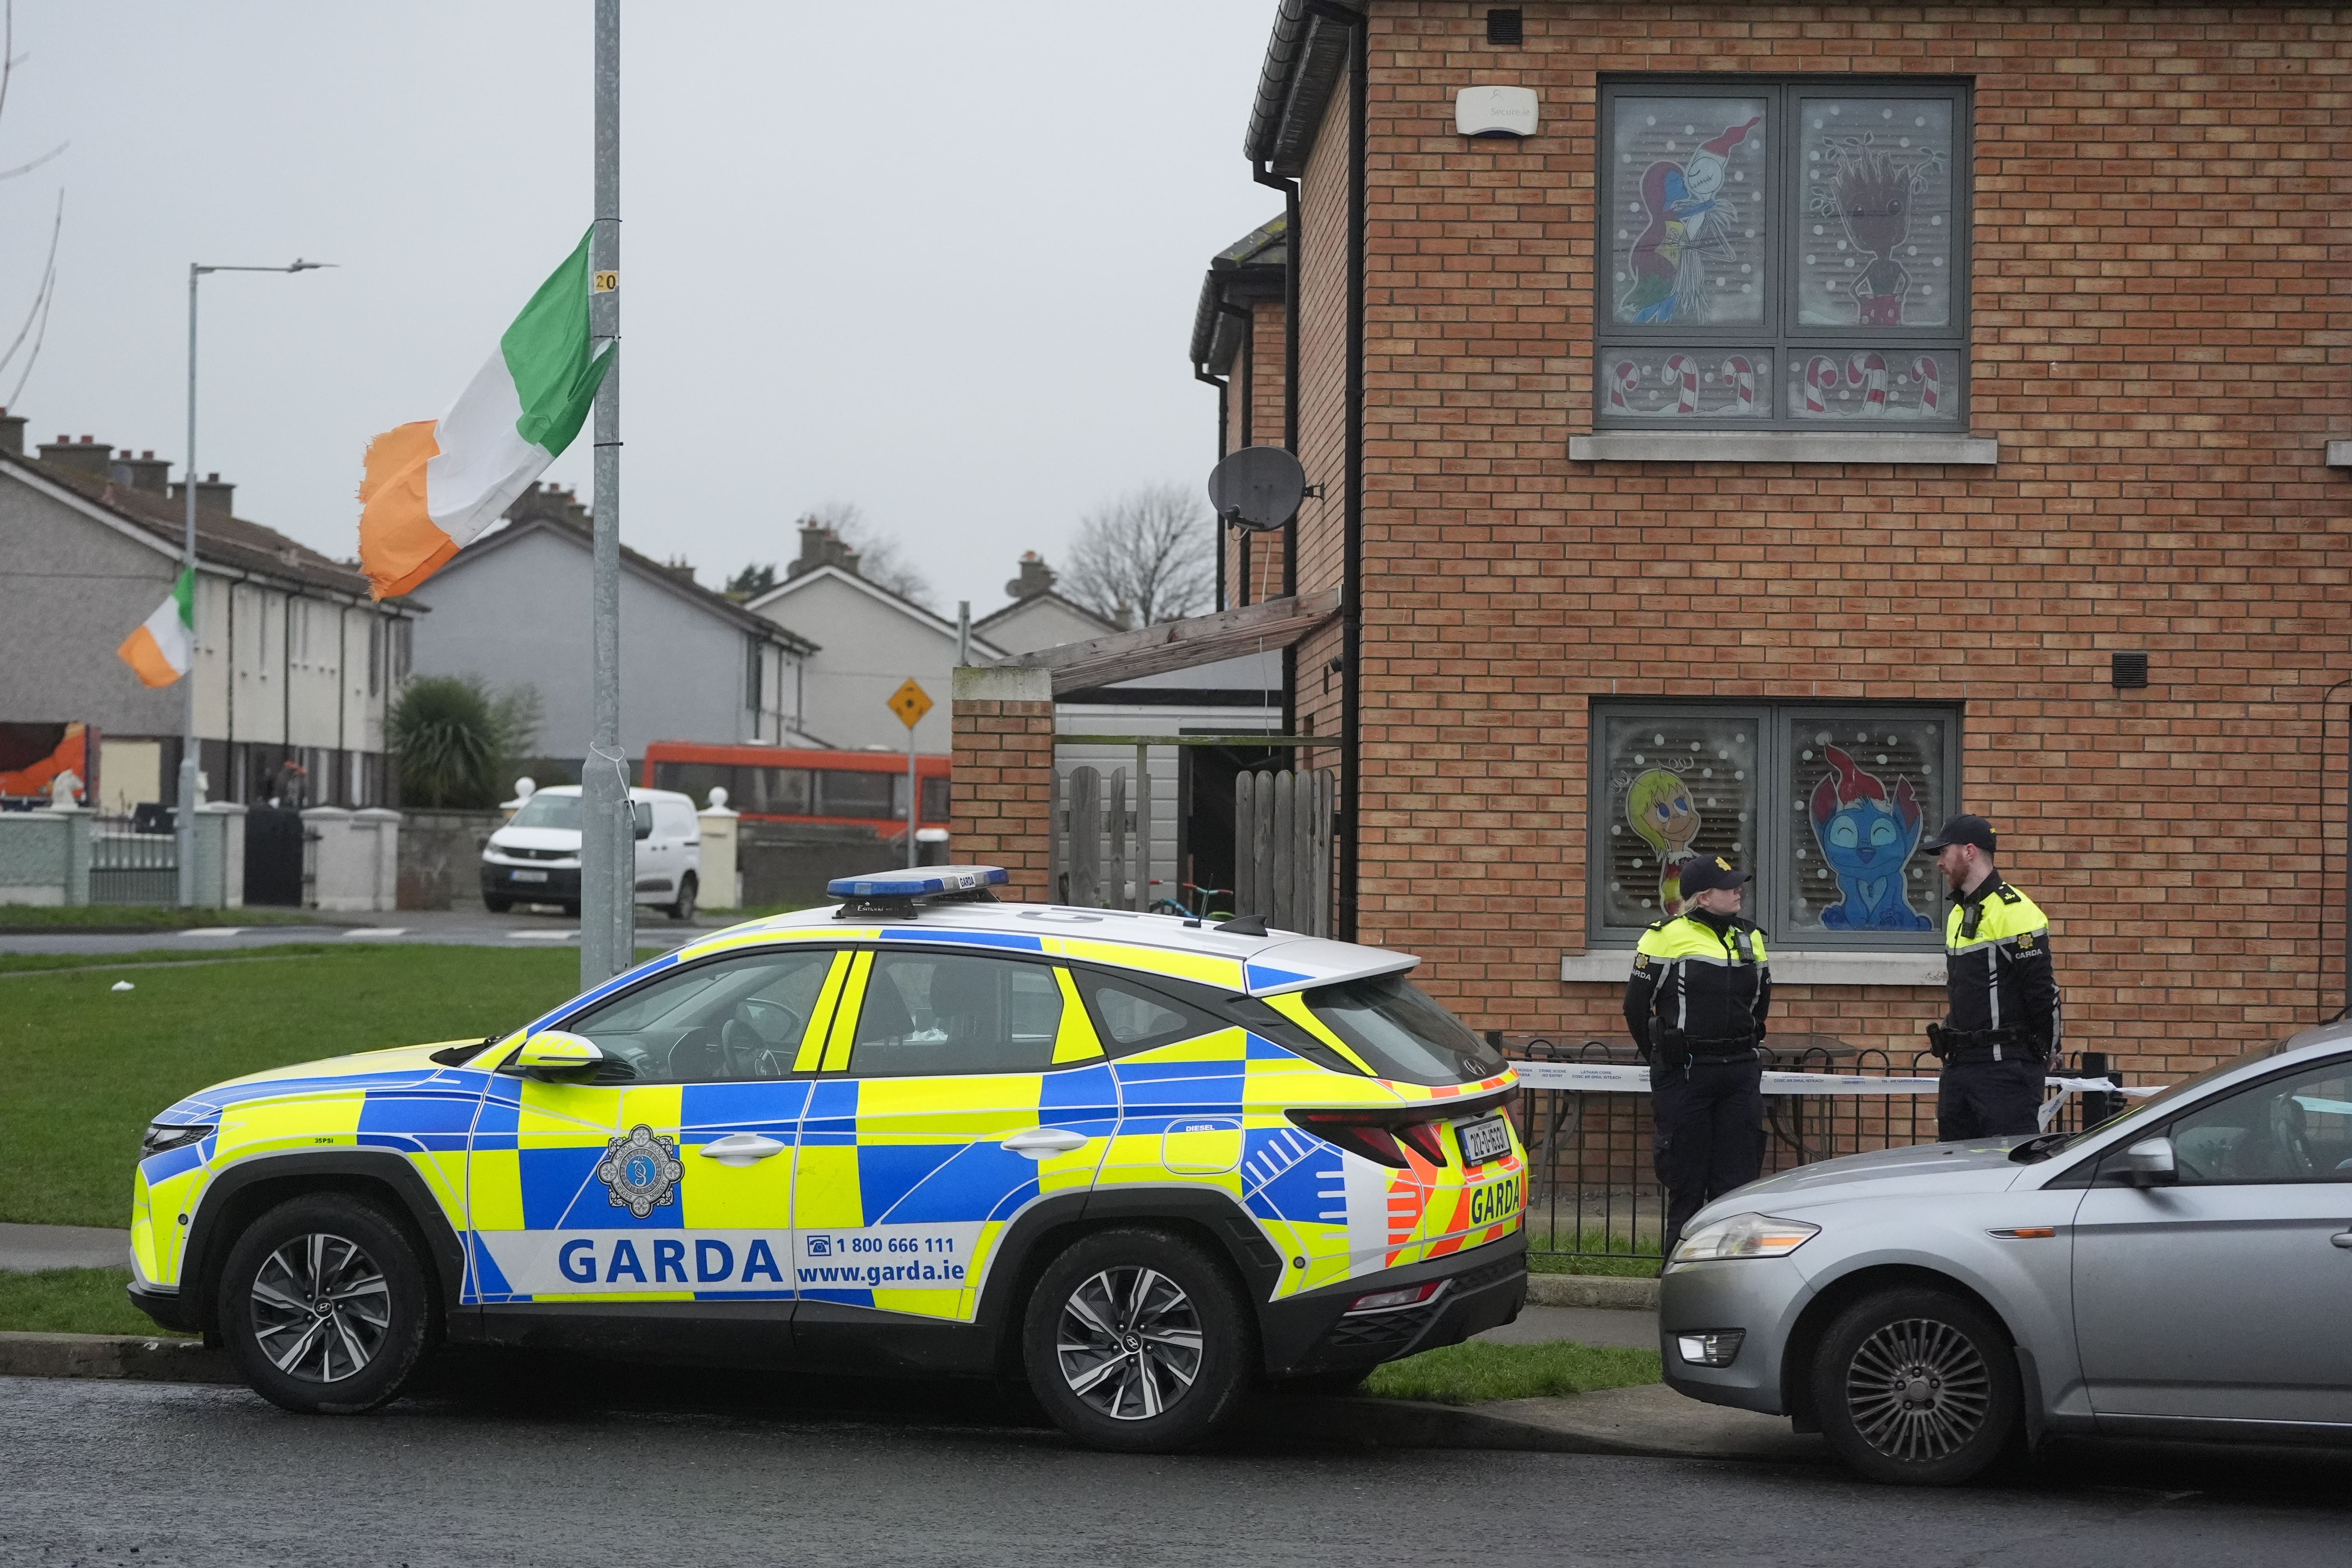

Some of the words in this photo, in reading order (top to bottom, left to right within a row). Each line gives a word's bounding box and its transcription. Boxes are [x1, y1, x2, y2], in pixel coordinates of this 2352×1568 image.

[1490, 107, 1530, 116] Secure.ie
[596, 275, 616, 289] 20
[960, 876, 975, 887] GARDA
[2015, 948, 2043, 959] GARDA
[1470, 1126, 1506, 1157] 212-D-16331
[1472, 1176, 1519, 1224] GARDA
[837, 1238, 845, 1252] 1
[852, 1238, 883, 1252] 800
[888, 1238, 918, 1252] 666
[925, 1238, 953, 1252] 111
[559, 1239, 783, 1283] GARDA
[797, 1259, 964, 1286] www.garda.ie
